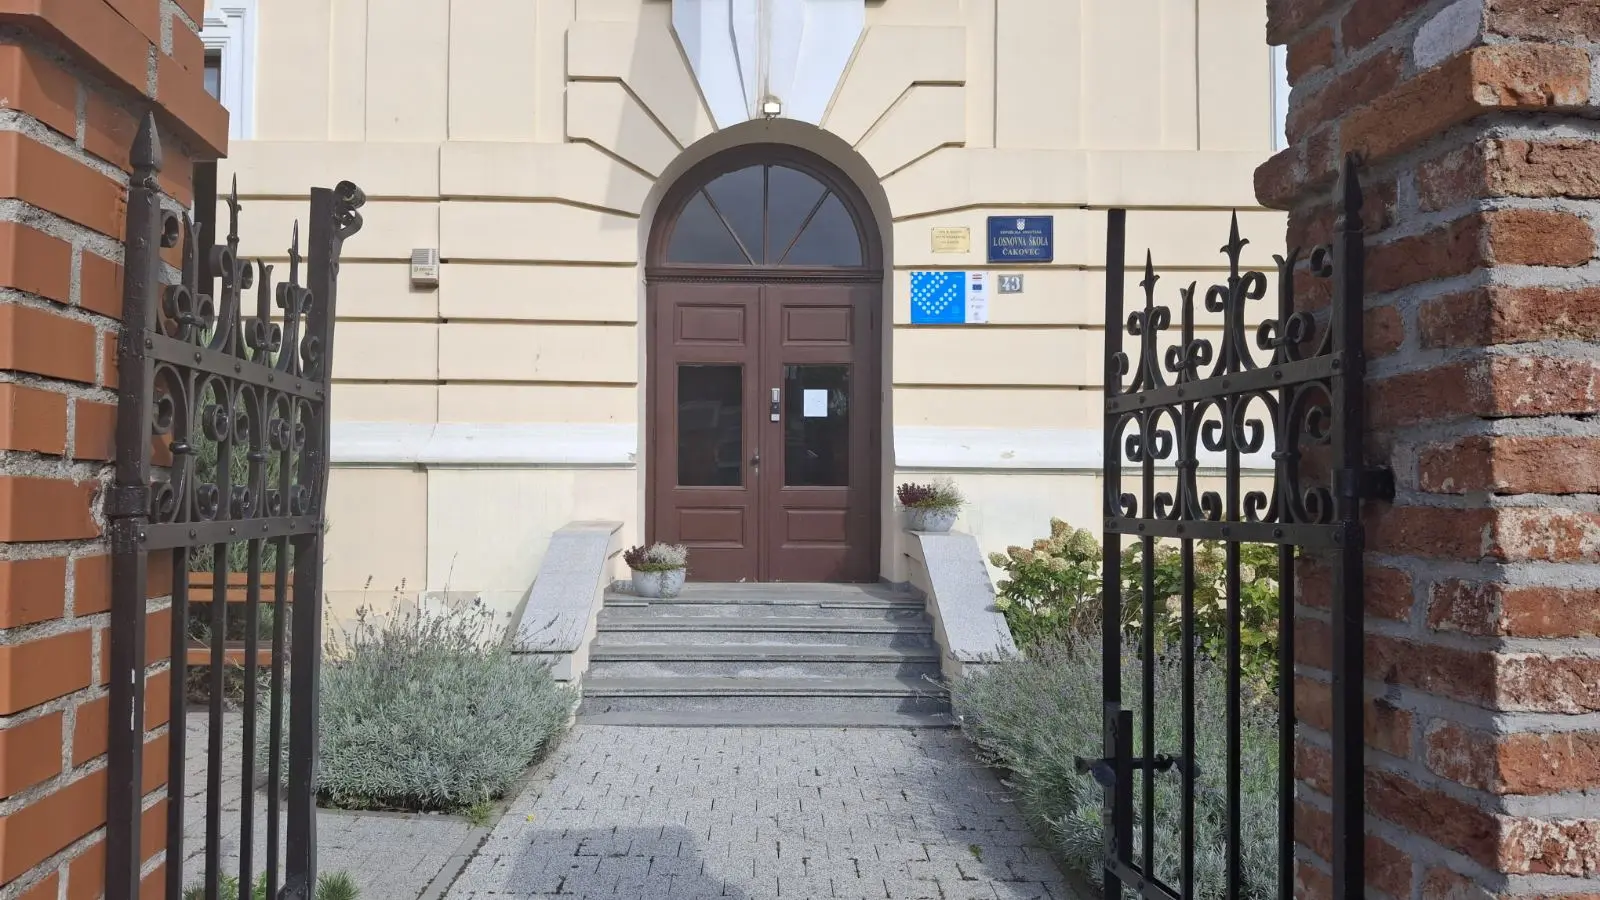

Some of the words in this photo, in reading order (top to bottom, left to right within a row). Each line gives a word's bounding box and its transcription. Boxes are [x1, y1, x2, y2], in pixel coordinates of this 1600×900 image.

[998, 237, 1026, 246] OSNOVNA
[1028, 235, 1048, 246] ŠKOLA
[1002, 247, 1040, 255] ČAKOVEC
[1002, 276, 1020, 291] 43
